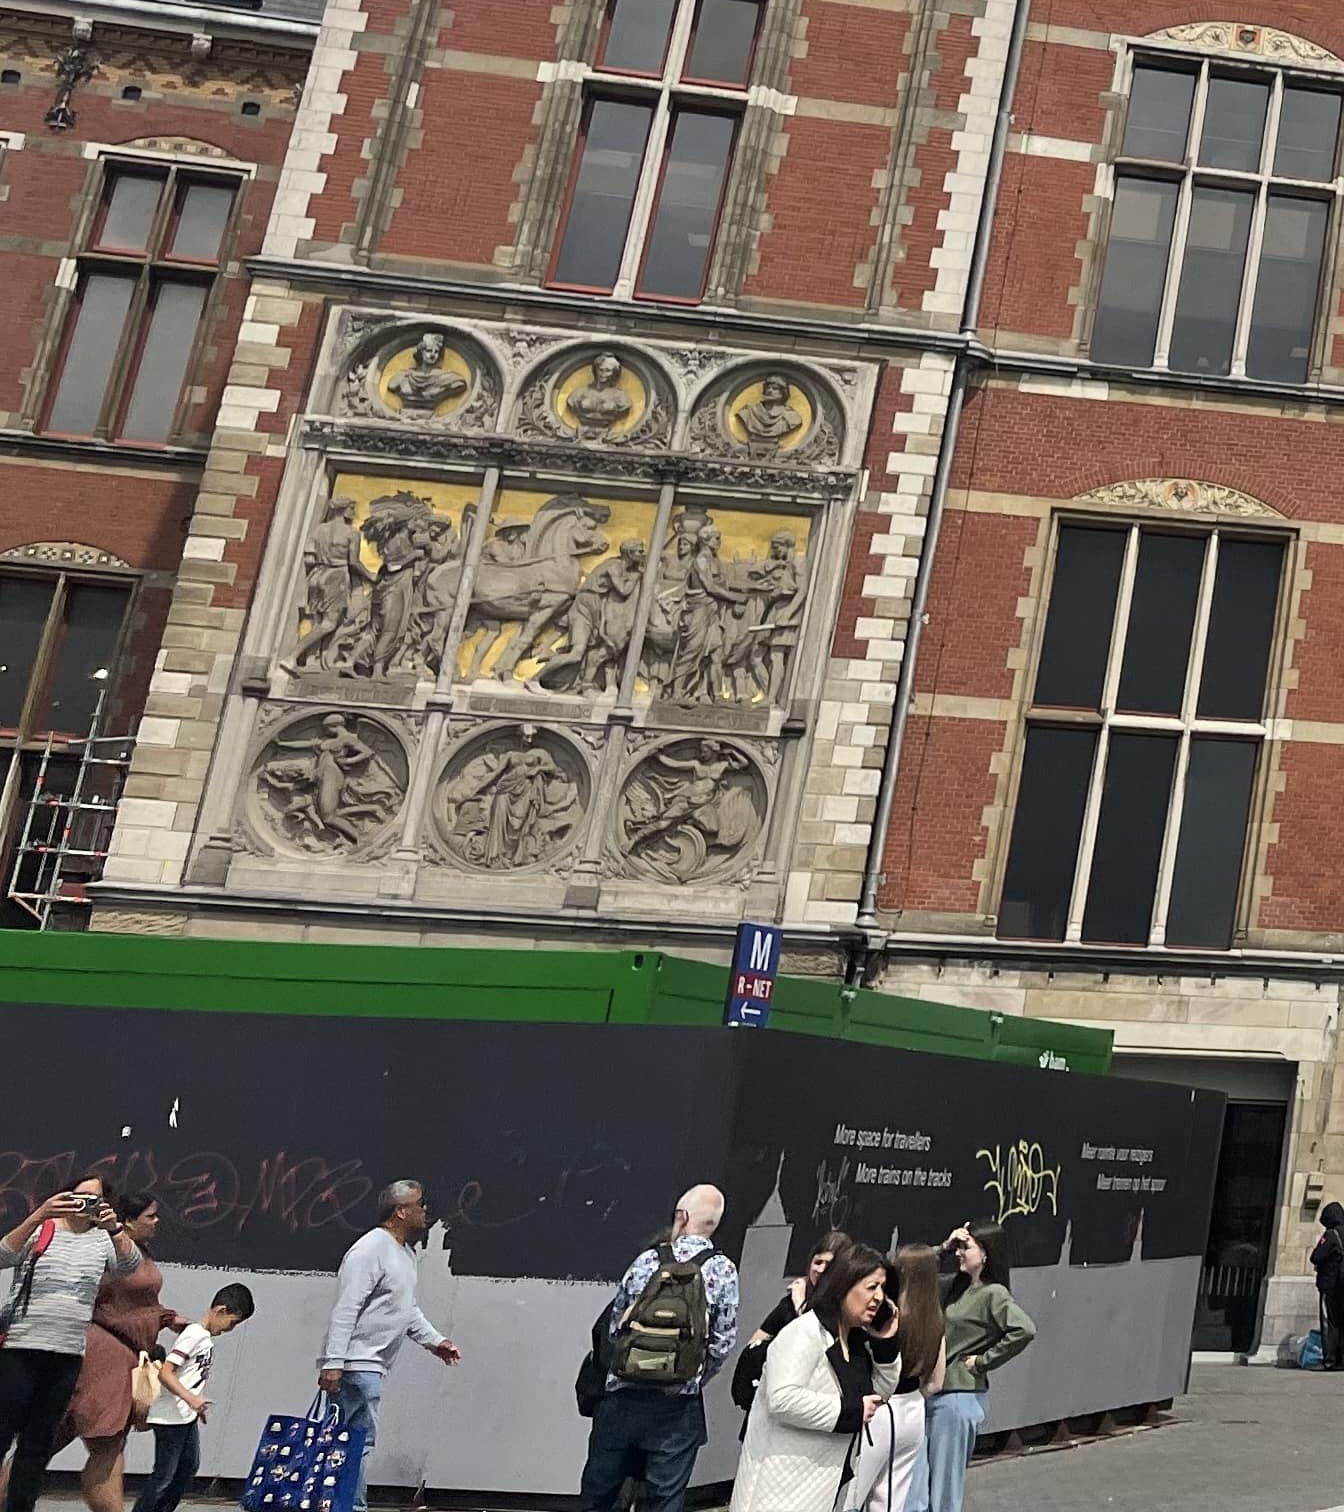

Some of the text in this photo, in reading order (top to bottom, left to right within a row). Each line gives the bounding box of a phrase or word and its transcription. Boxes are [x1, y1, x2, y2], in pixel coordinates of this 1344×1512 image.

[750, 930, 773, 971] M
[834, 1123, 931, 1152] More space for travellers
[855, 1162, 953, 1187] More trains on the tracks
